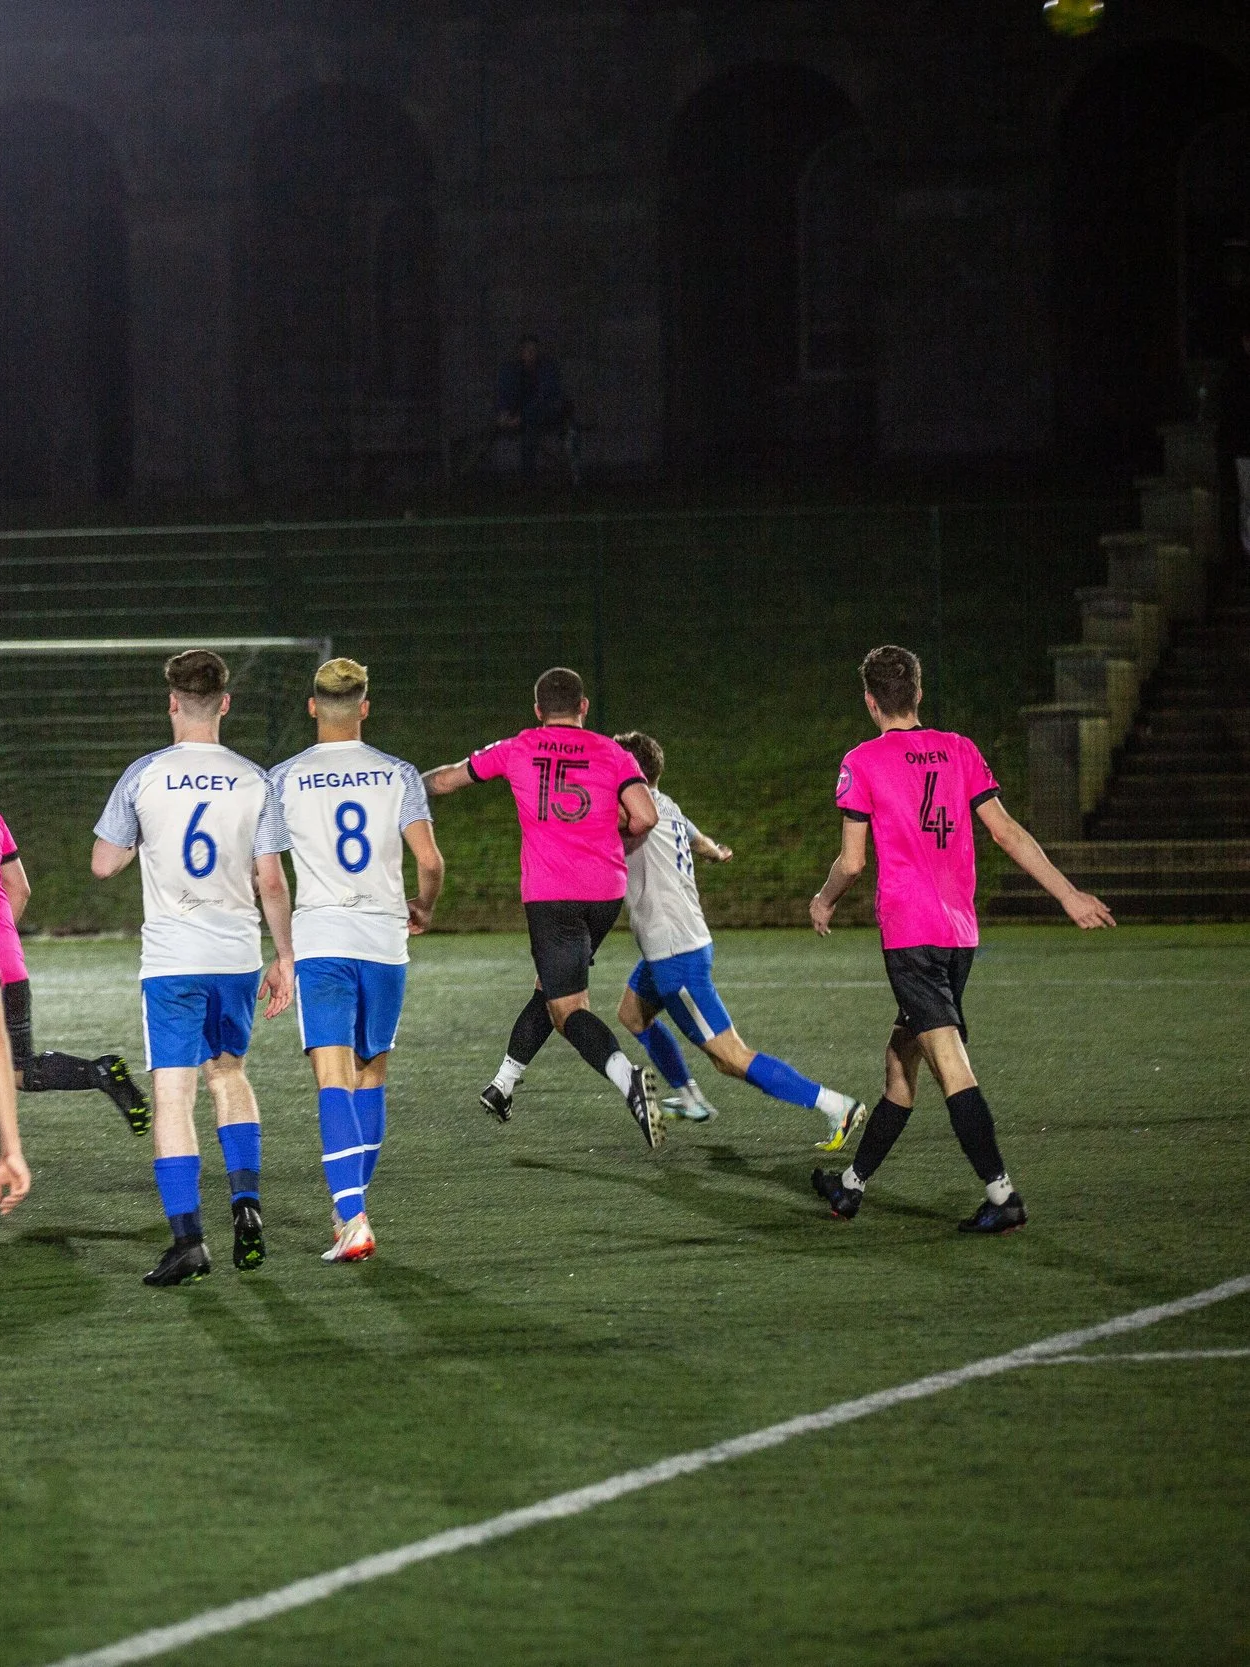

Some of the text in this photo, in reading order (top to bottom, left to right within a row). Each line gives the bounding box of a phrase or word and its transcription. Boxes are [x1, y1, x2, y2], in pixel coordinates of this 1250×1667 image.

[537, 741, 585, 754] HAIGH
[905, 750, 949, 765] OWEN
[166, 774, 238, 791] LACEY
[299, 771, 394, 791] HEGARTY
[532, 757, 591, 823] 15
[919, 771, 955, 849] 4
[183, 801, 217, 879] 6
[335, 800, 371, 873] 8
